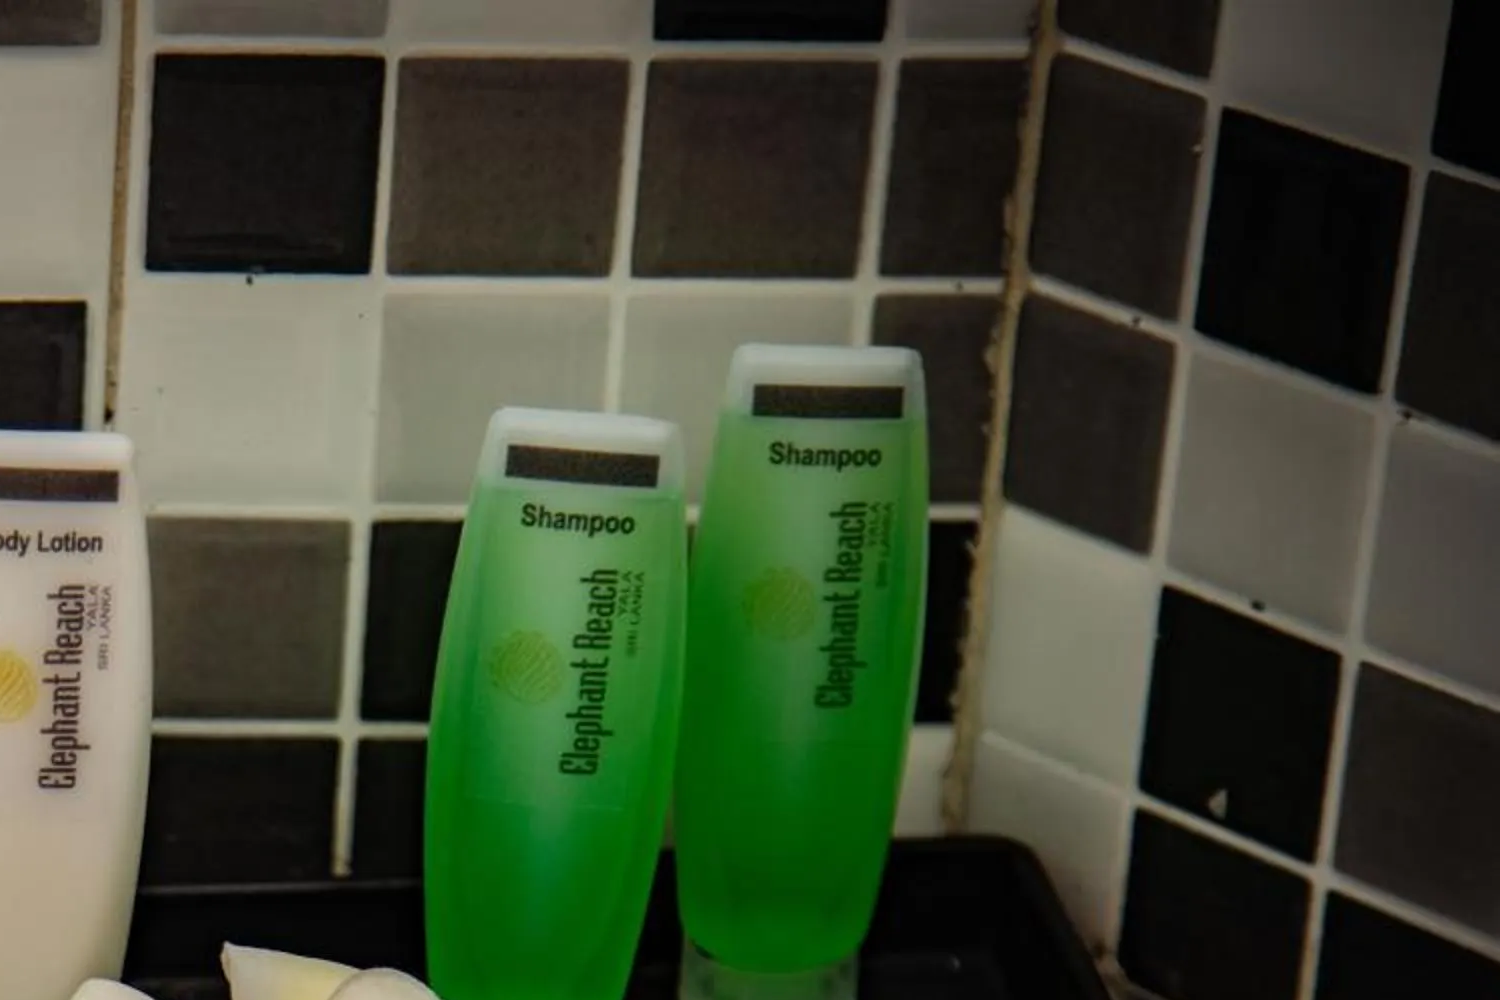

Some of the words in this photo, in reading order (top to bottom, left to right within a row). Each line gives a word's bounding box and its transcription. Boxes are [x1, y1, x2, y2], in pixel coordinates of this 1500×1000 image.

[768, 441, 882, 473] Shampoo
[37, 529, 104, 553] Lotion
[520, 503, 637, 539] Shampoo
[823, 501, 868, 584] Reach
[43, 584, 86, 665] Reach
[86, 585, 99, 631] YALA
[99, 585, 112, 639] LANKA
[572, 568, 619, 650] Reach
[814, 589, 868, 709] Elephant
[38, 671, 91, 790] Elephant
[559, 655, 614, 776] Elephant
